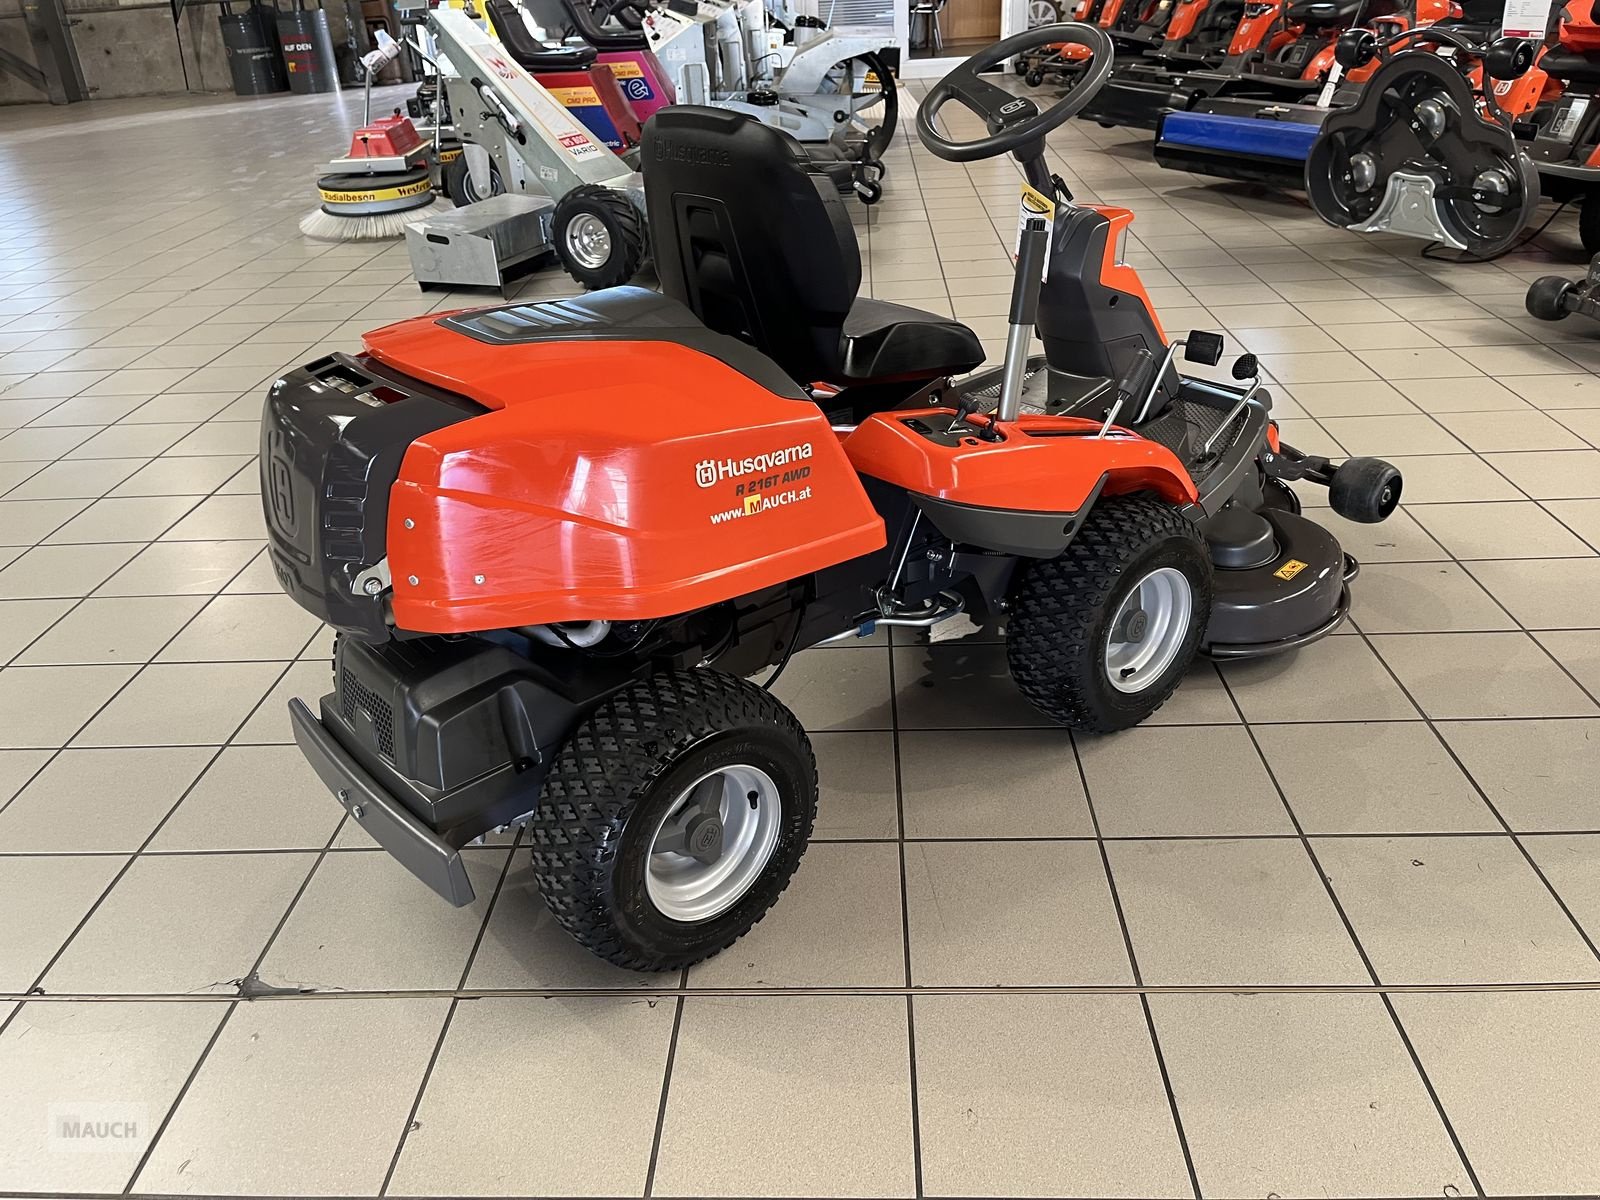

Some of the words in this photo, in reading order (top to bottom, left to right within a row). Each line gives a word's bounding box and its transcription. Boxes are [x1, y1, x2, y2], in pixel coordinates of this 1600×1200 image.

[296, 43, 312, 51] DEN
[568, 144, 598, 156] VARIO
[718, 442, 813, 480] Husqvarna
[736, 484, 745, 496] R
[748, 475, 780, 493] 216T
[782, 466, 811, 484] AWD
[710, 486, 812, 525] www.MAUCH.at
